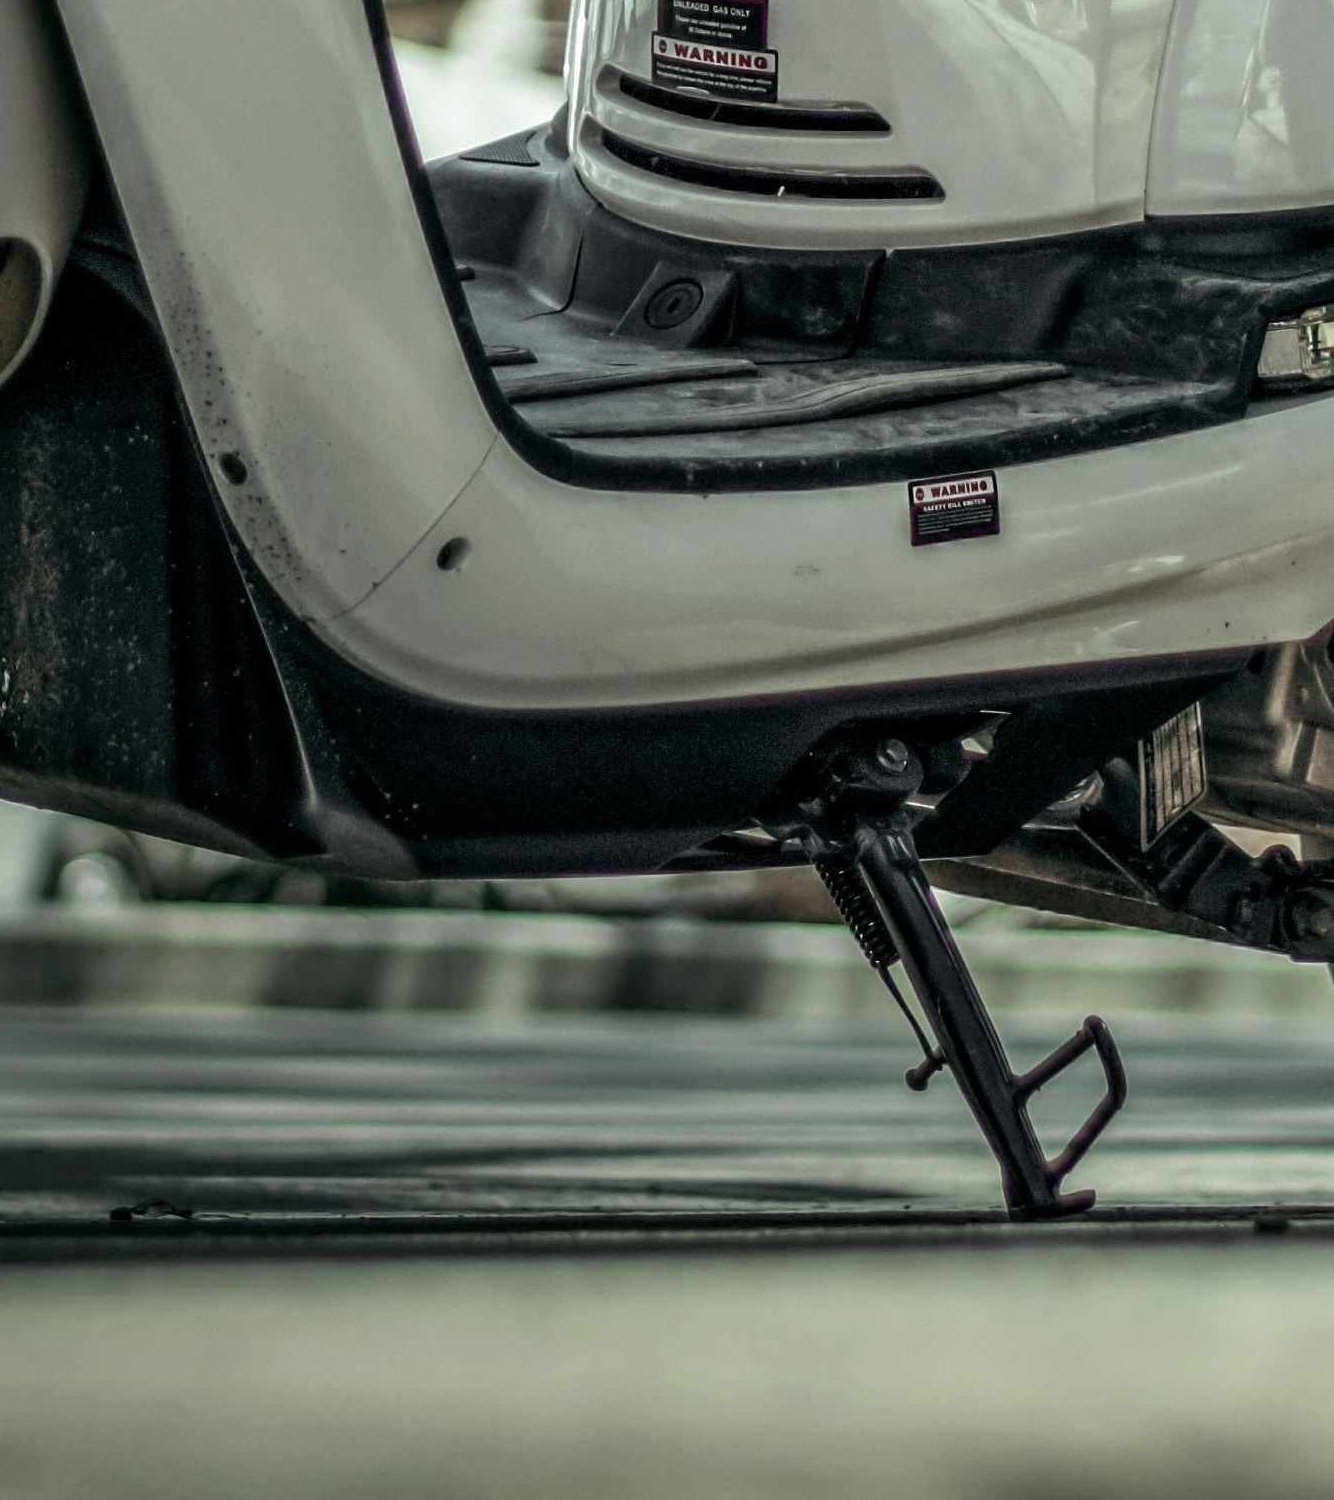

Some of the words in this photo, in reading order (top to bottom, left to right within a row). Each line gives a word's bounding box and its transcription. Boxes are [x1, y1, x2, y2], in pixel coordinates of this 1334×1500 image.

[673, 0, 709, 11] UNLEADED
[713, 5, 728, 15] GAS
[730, 7, 750, 17] ONLY
[674, 43, 768, 69] WARNING
[931, 480, 988, 497] WARNING
